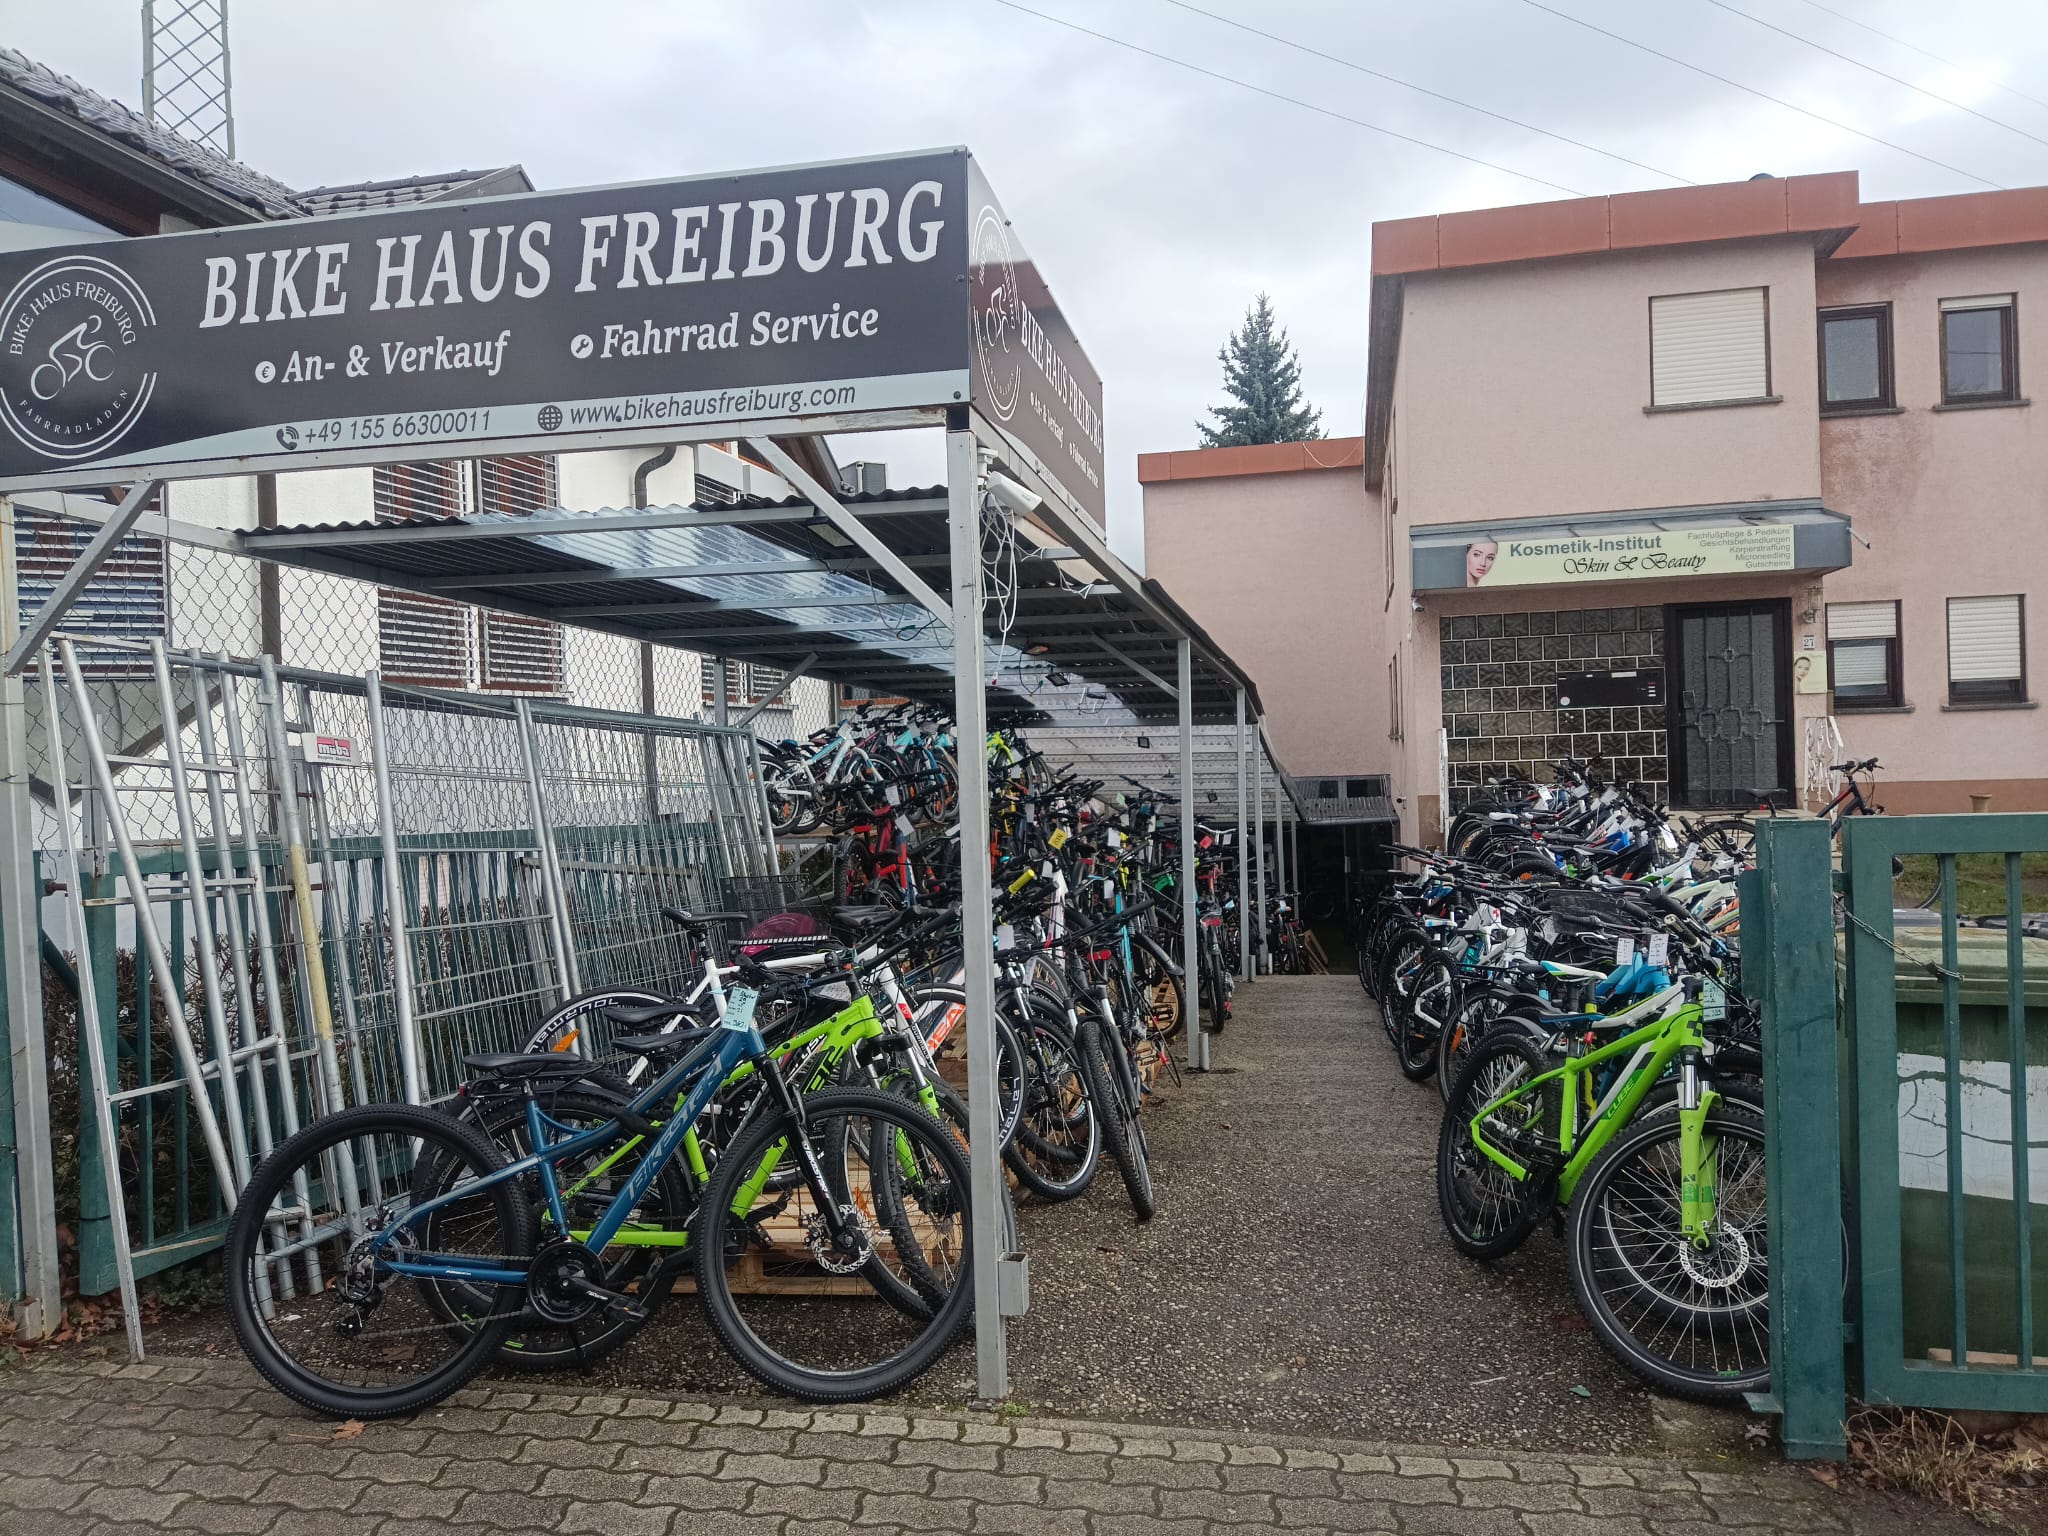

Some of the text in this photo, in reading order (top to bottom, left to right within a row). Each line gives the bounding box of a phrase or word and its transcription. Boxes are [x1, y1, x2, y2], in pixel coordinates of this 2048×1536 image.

[200, 243, 350, 329] BIKE
[370, 221, 552, 311] HAUS
[575, 181, 945, 293] FREIBURG
[10, 282, 136, 355] BIKE HAUS FREIBURG
[601, 303, 879, 359] Fahrrad Service
[282, 330, 511, 383] An- & Verkauf
[1021, 300, 1044, 371] BIKE
[1046, 338, 1068, 405] HAUS
[20, 389, 128, 435] FAHRRADLADEN
[305, 410, 490, 444] +49 155 66300011
[571, 387, 856, 425] www.bikehausfreiburg.com
[1510, 535, 1662, 557] Kosmetik-Institut
[1563, 555, 1609, 574] Skin
[1641, 553, 1706, 572] Beauty
[1607, 1077, 1634, 1118] CUBE
